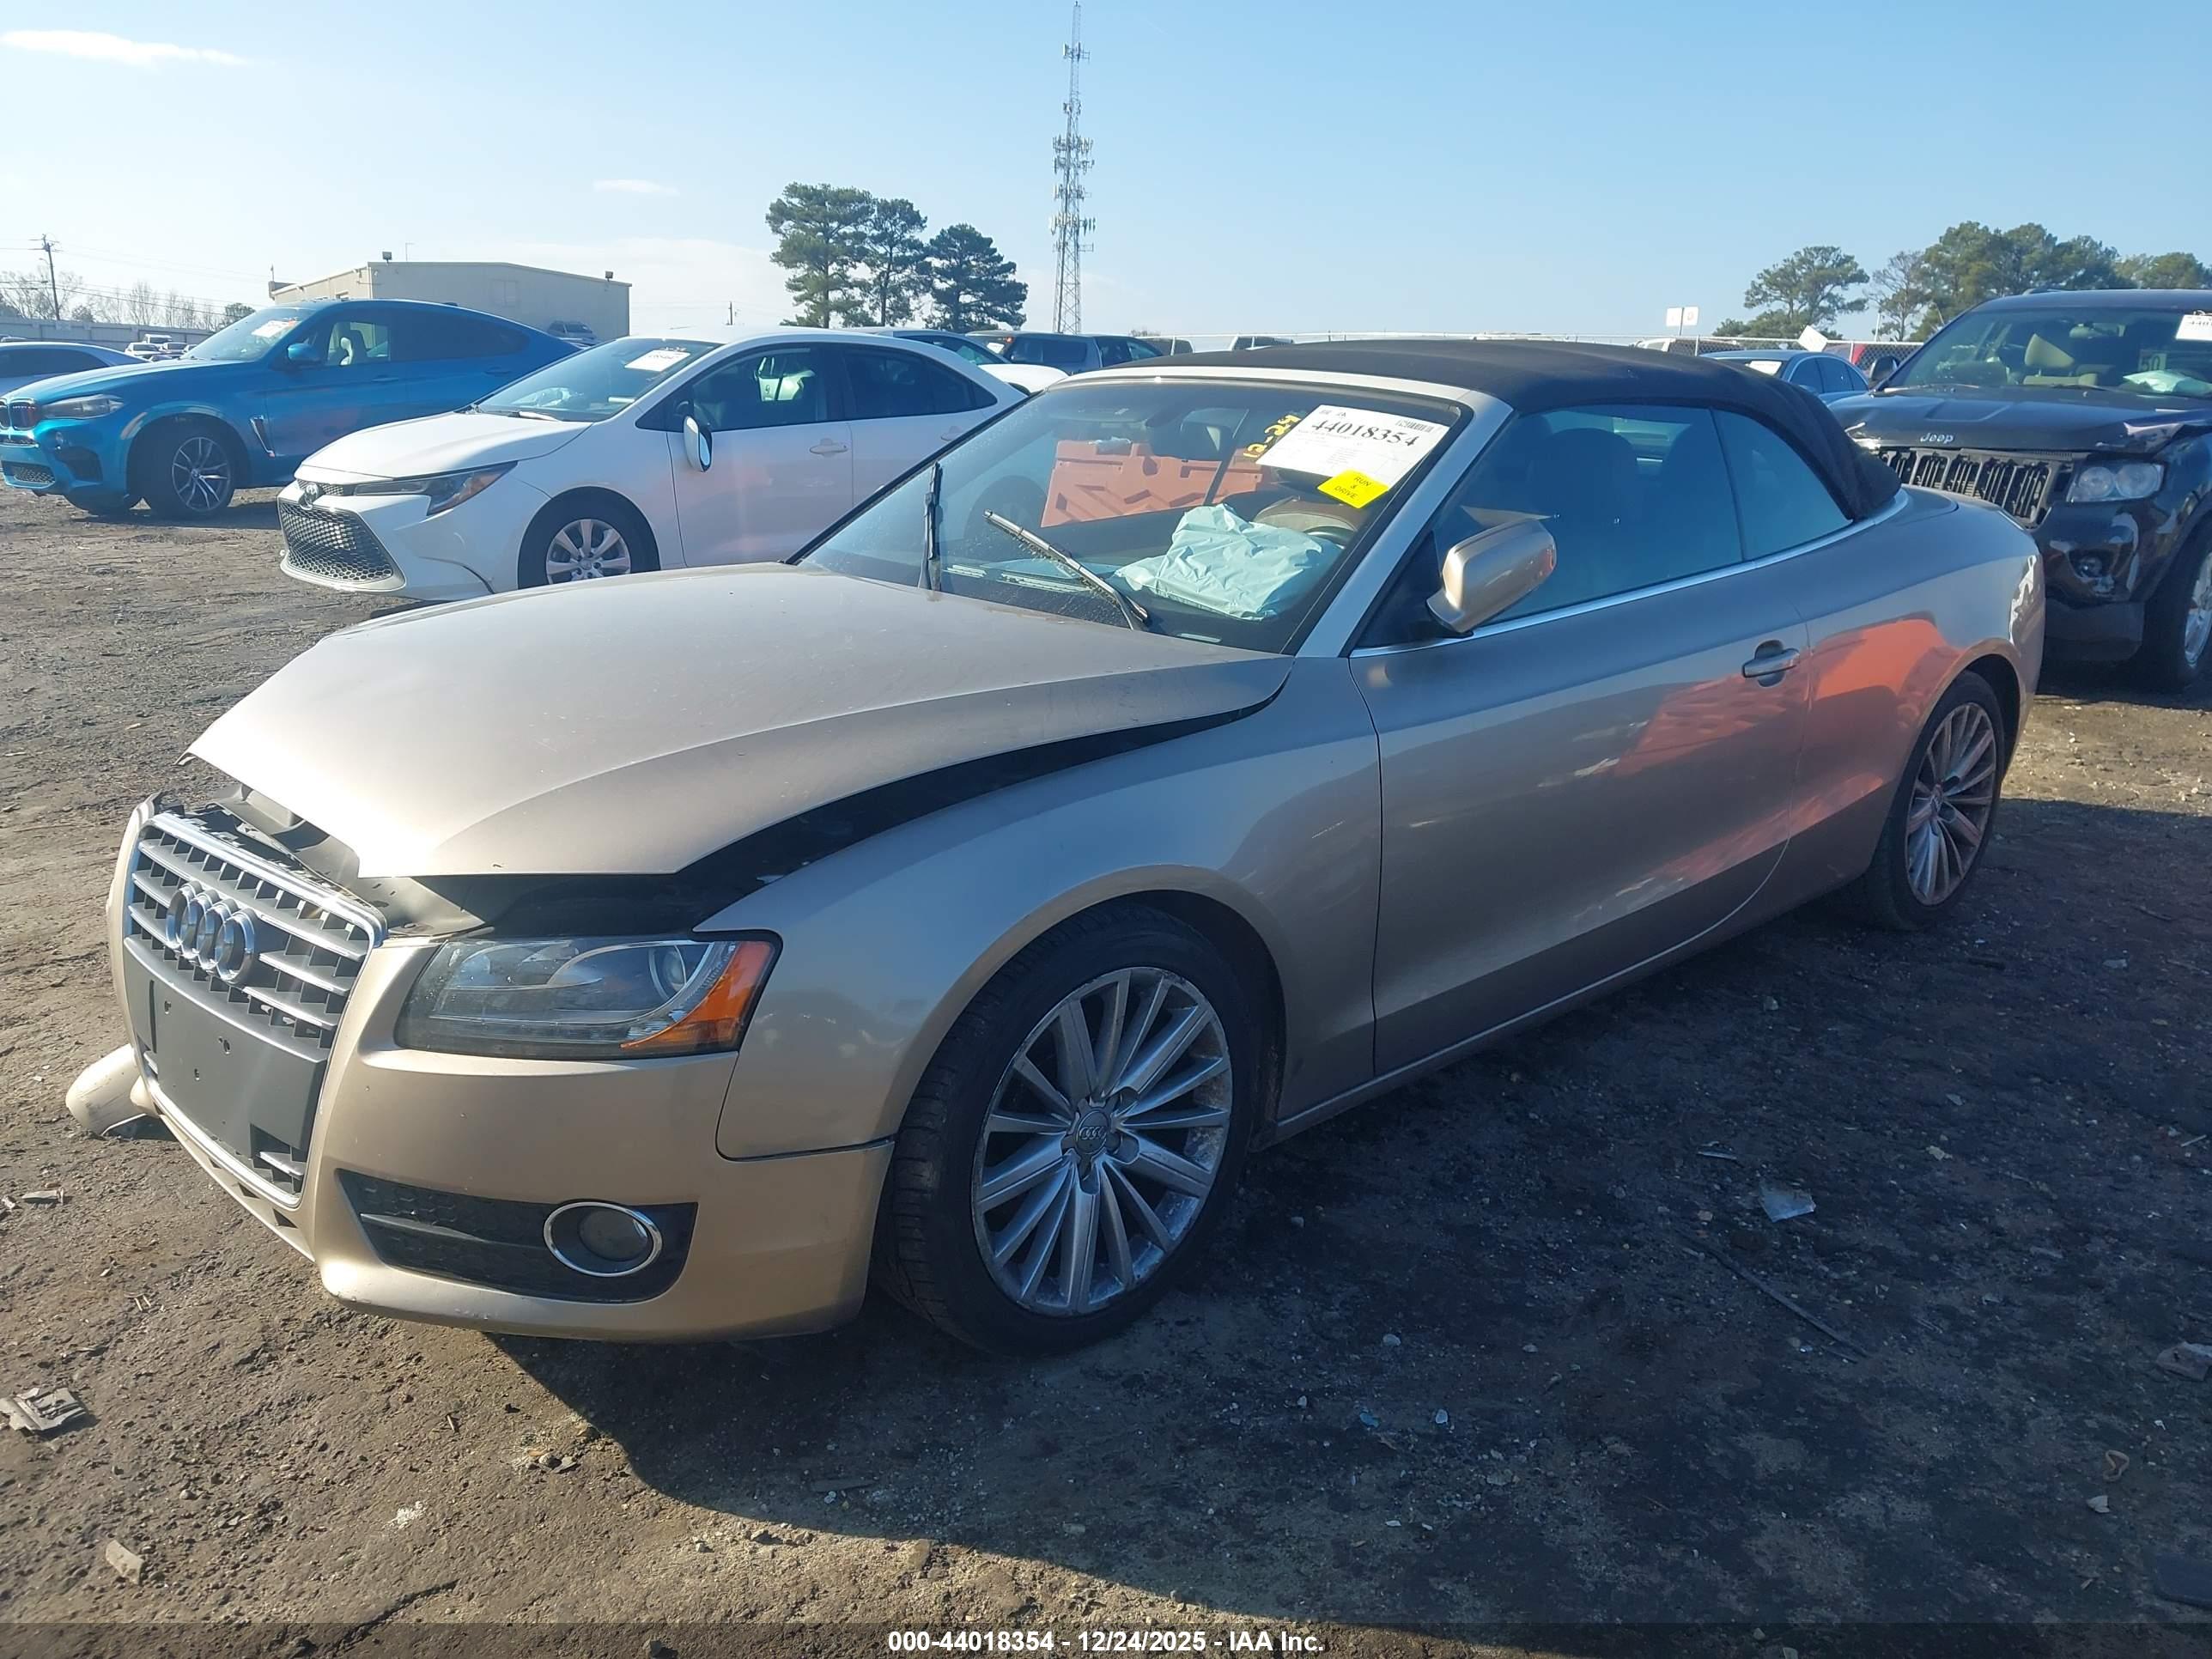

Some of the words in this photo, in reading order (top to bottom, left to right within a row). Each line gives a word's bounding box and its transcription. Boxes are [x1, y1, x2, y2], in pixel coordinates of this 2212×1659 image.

[1311, 419, 1420, 447] 44018354
[1919, 432, 1954, 445] Jeep
[1353, 476, 1372, 487] RUN
[1334, 485, 1358, 499] DRIVE
